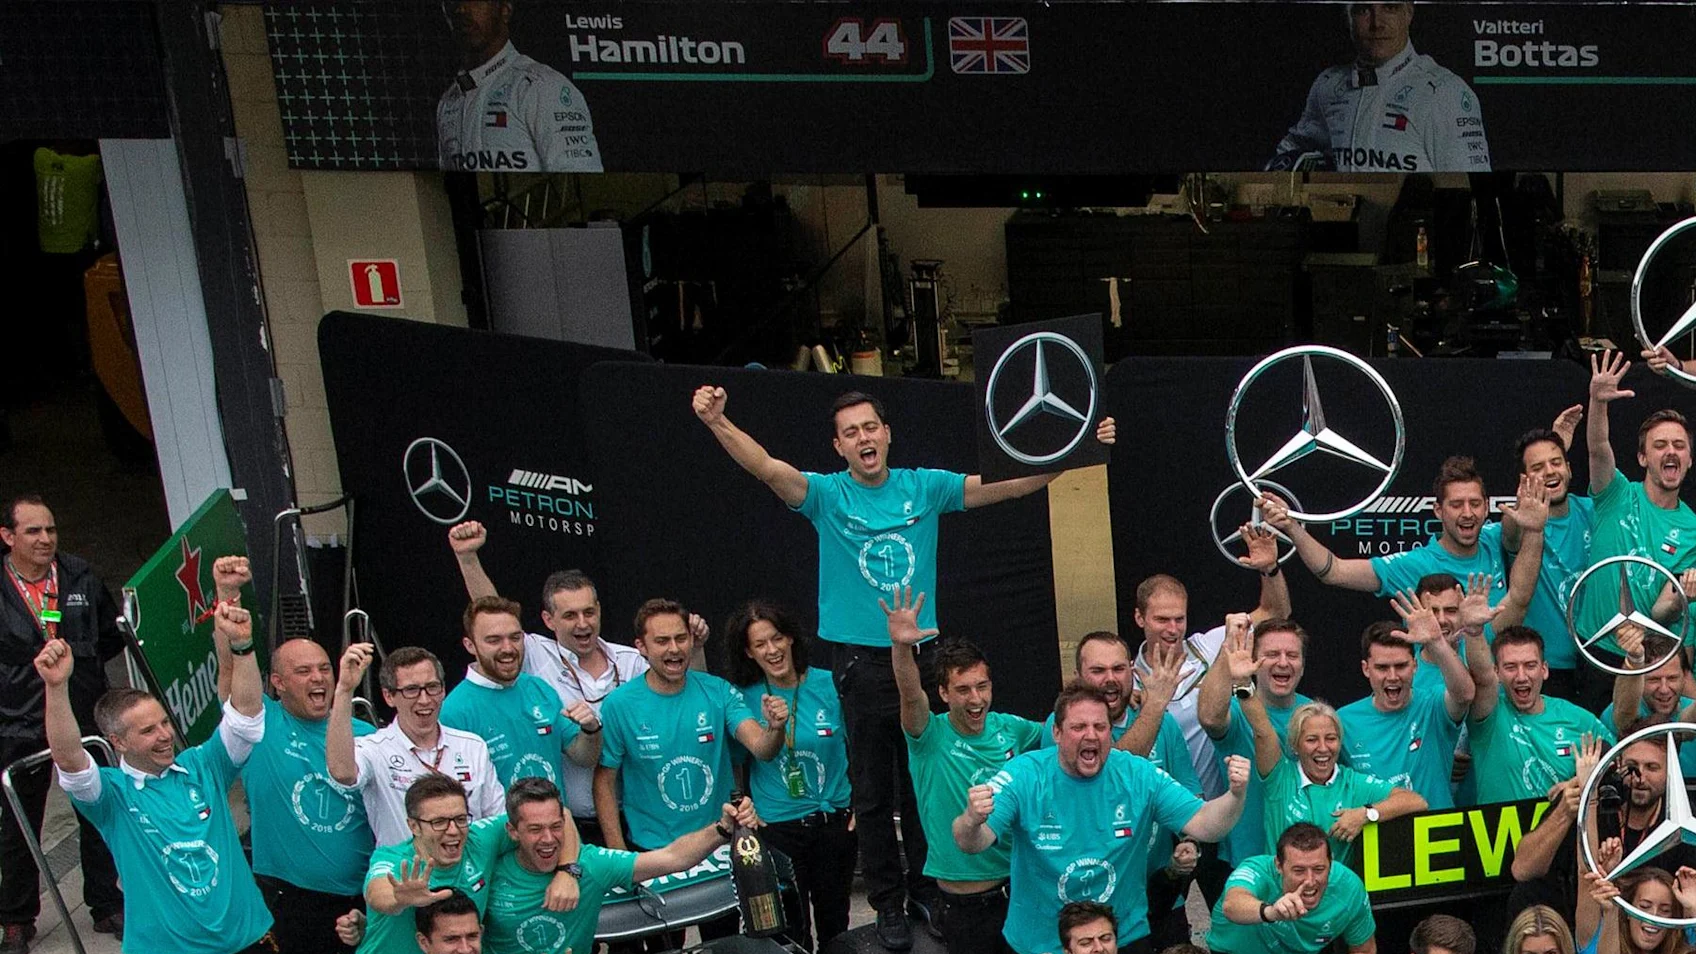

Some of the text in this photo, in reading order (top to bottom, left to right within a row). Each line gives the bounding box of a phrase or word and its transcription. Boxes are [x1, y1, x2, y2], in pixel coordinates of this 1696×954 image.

[566, 14, 623, 29] Lewis
[1473, 20, 1544, 35] Valtteri
[569, 34, 745, 64] Hamilton
[825, 20, 906, 62] 44
[1474, 40, 1599, 68] Bottas
[554, 112, 587, 122] EPSON
[565, 135, 588, 145] IWC
[489, 486, 597, 519] PETRON
[510, 511, 595, 537] MOTORSP
[166, 650, 218, 736] Heine
[671, 755, 704, 768] WINNERS
[675, 767, 692, 800] 1
[679, 804, 699, 812] 2018
[311, 824, 334, 834] 2018
